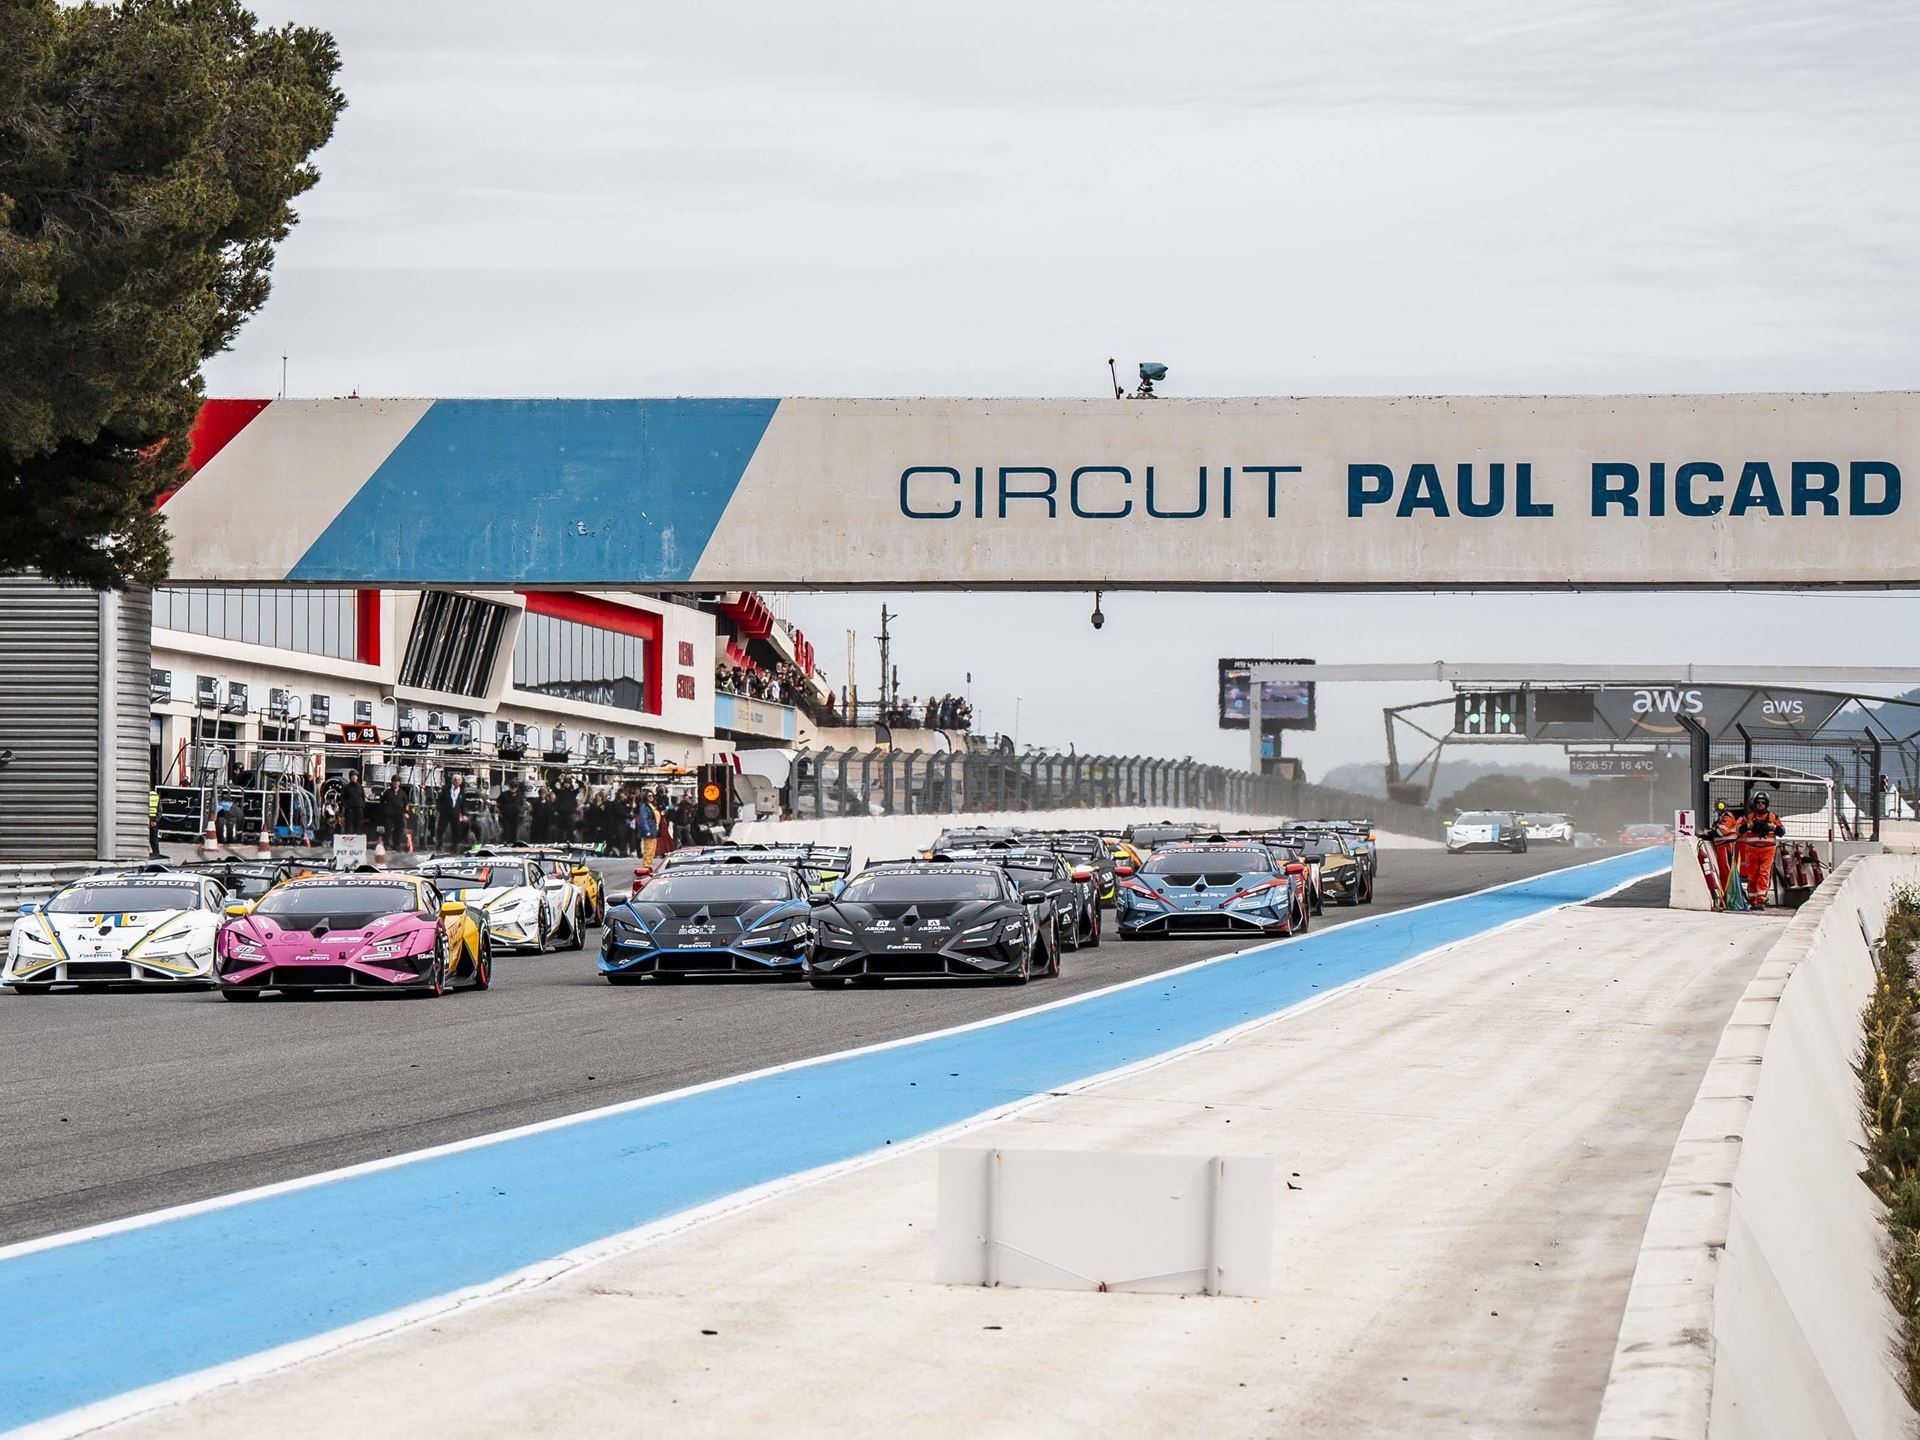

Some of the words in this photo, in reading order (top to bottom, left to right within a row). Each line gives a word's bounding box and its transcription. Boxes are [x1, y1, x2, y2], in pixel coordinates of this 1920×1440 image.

[900, 466, 1302, 518] CIRCUIT
[1348, 463, 1553, 517] PAUL
[1592, 462, 1901, 516] RICARD
[1632, 689, 1704, 713] aws
[1762, 699, 1804, 714] aws
[346, 731, 357, 742] 19
[363, 728, 374, 738] 63
[401, 737, 410, 747] 19
[416, 733, 427, 743] 63
[661, 870, 714, 878] ROGER
[865, 869, 920, 877] ROGER
[75, 880, 128, 889] ROGER
[284, 880, 339, 889] ROGER
